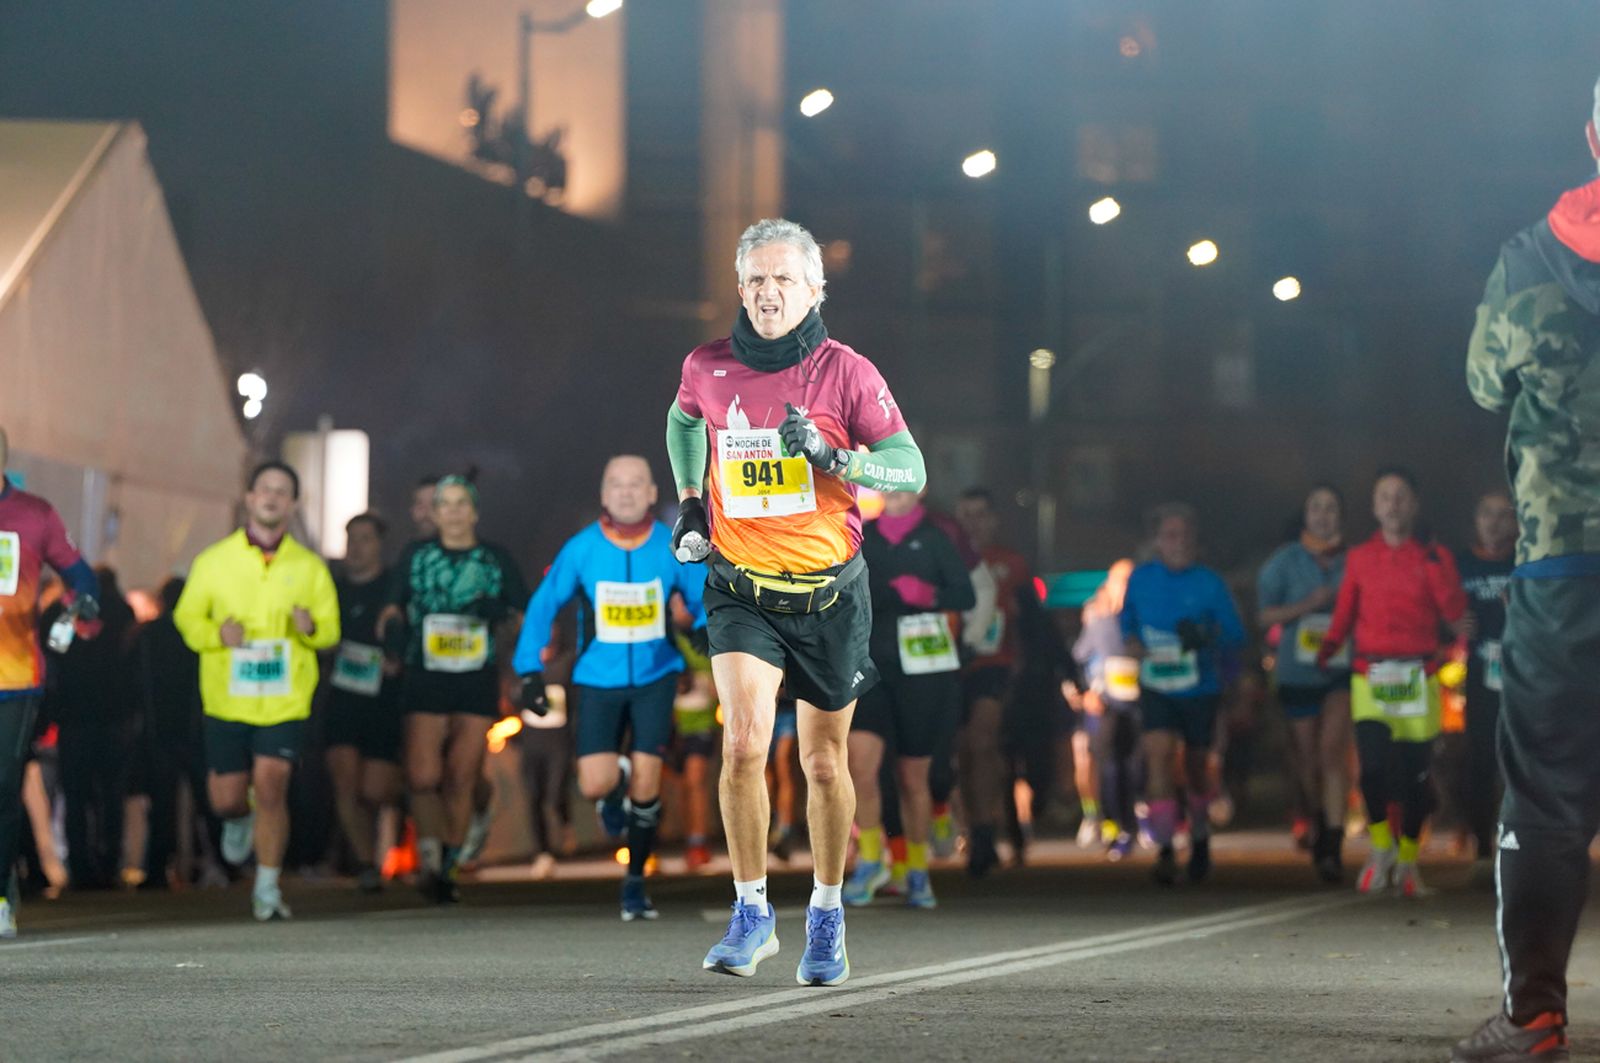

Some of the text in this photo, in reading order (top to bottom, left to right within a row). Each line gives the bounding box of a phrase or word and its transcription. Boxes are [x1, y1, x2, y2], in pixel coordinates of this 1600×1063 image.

[734, 438, 772, 448] NOCHE DE
[726, 449, 742, 460] SAN
[742, 461, 784, 487] 941
[864, 462, 916, 482] CAJA RURAL
